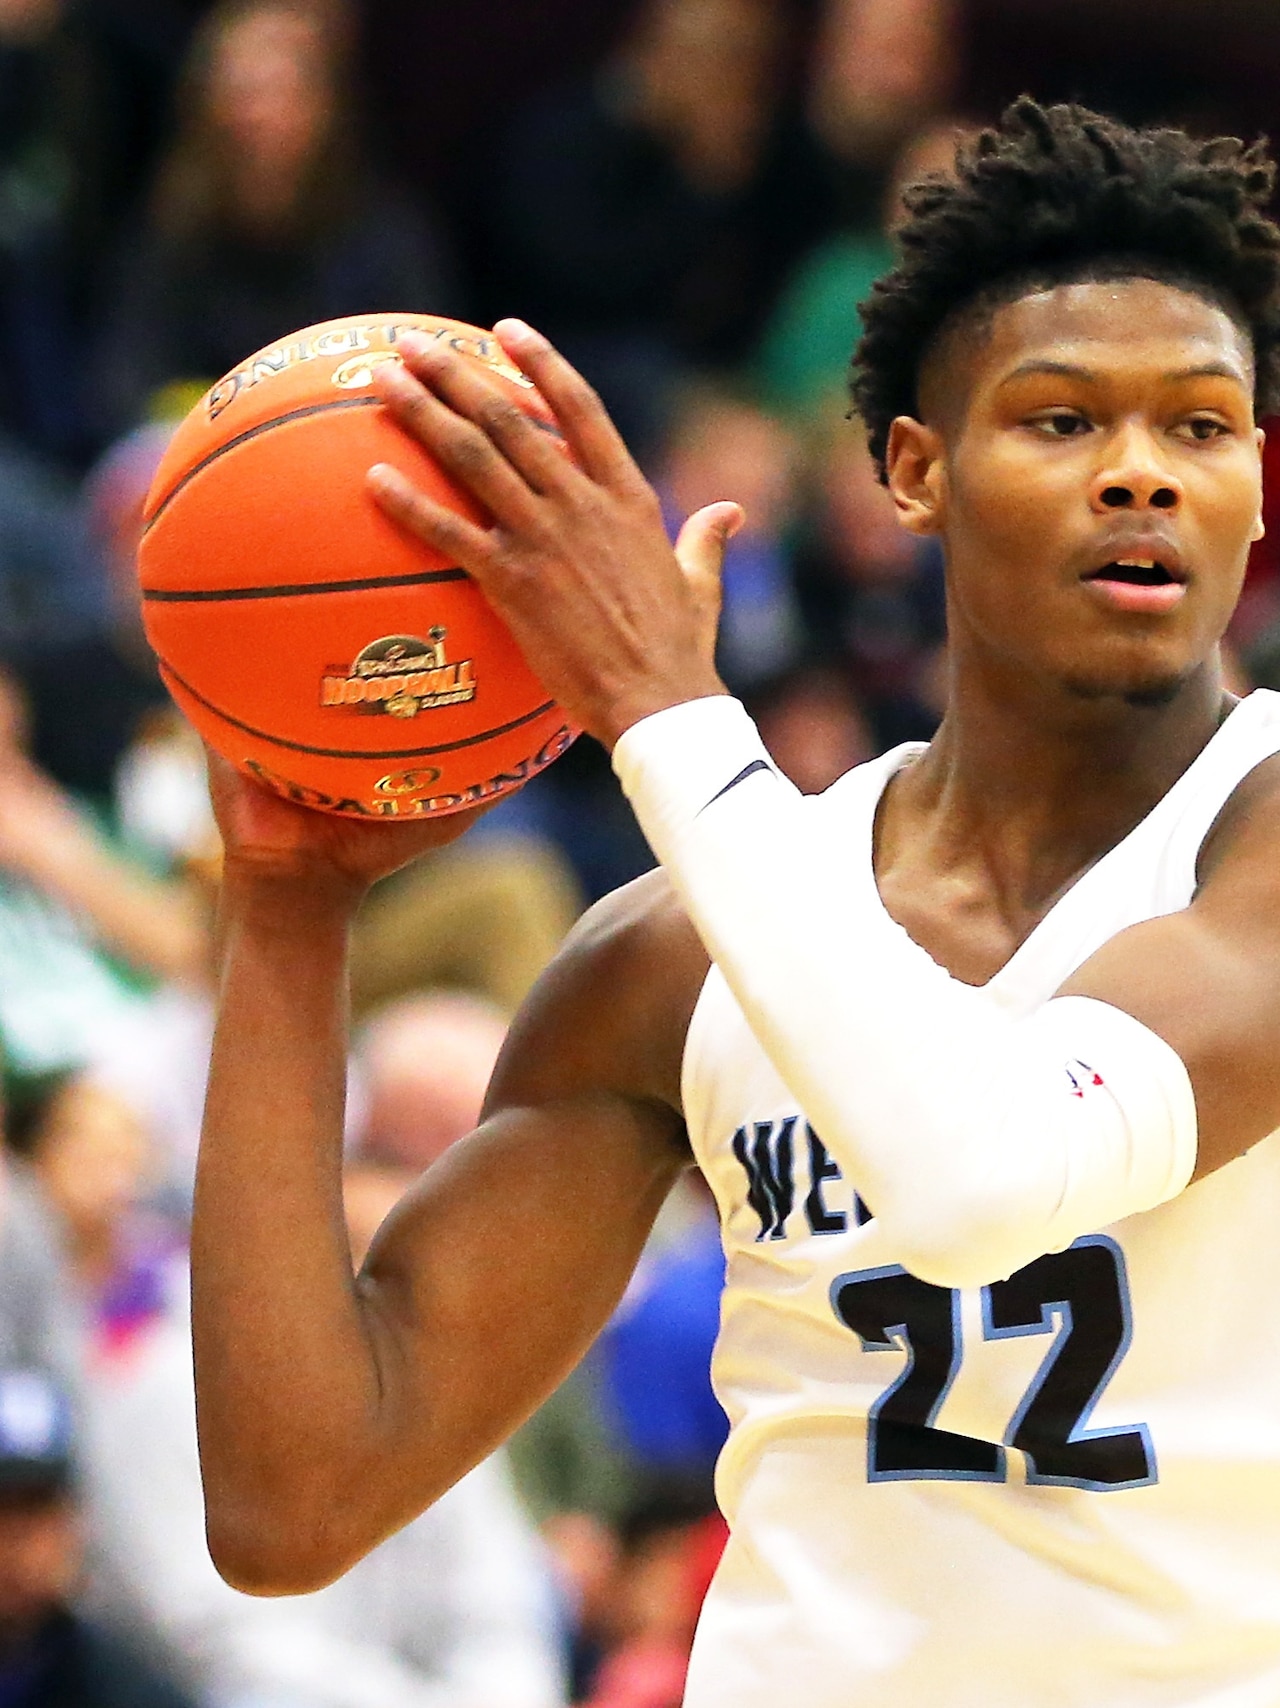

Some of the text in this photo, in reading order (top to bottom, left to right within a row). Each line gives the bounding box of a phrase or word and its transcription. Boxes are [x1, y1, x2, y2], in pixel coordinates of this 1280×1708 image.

[207, 324, 498, 421] PLDING
[731, 1114, 876, 1243] WE
[828, 1232, 1160, 1494] 22
